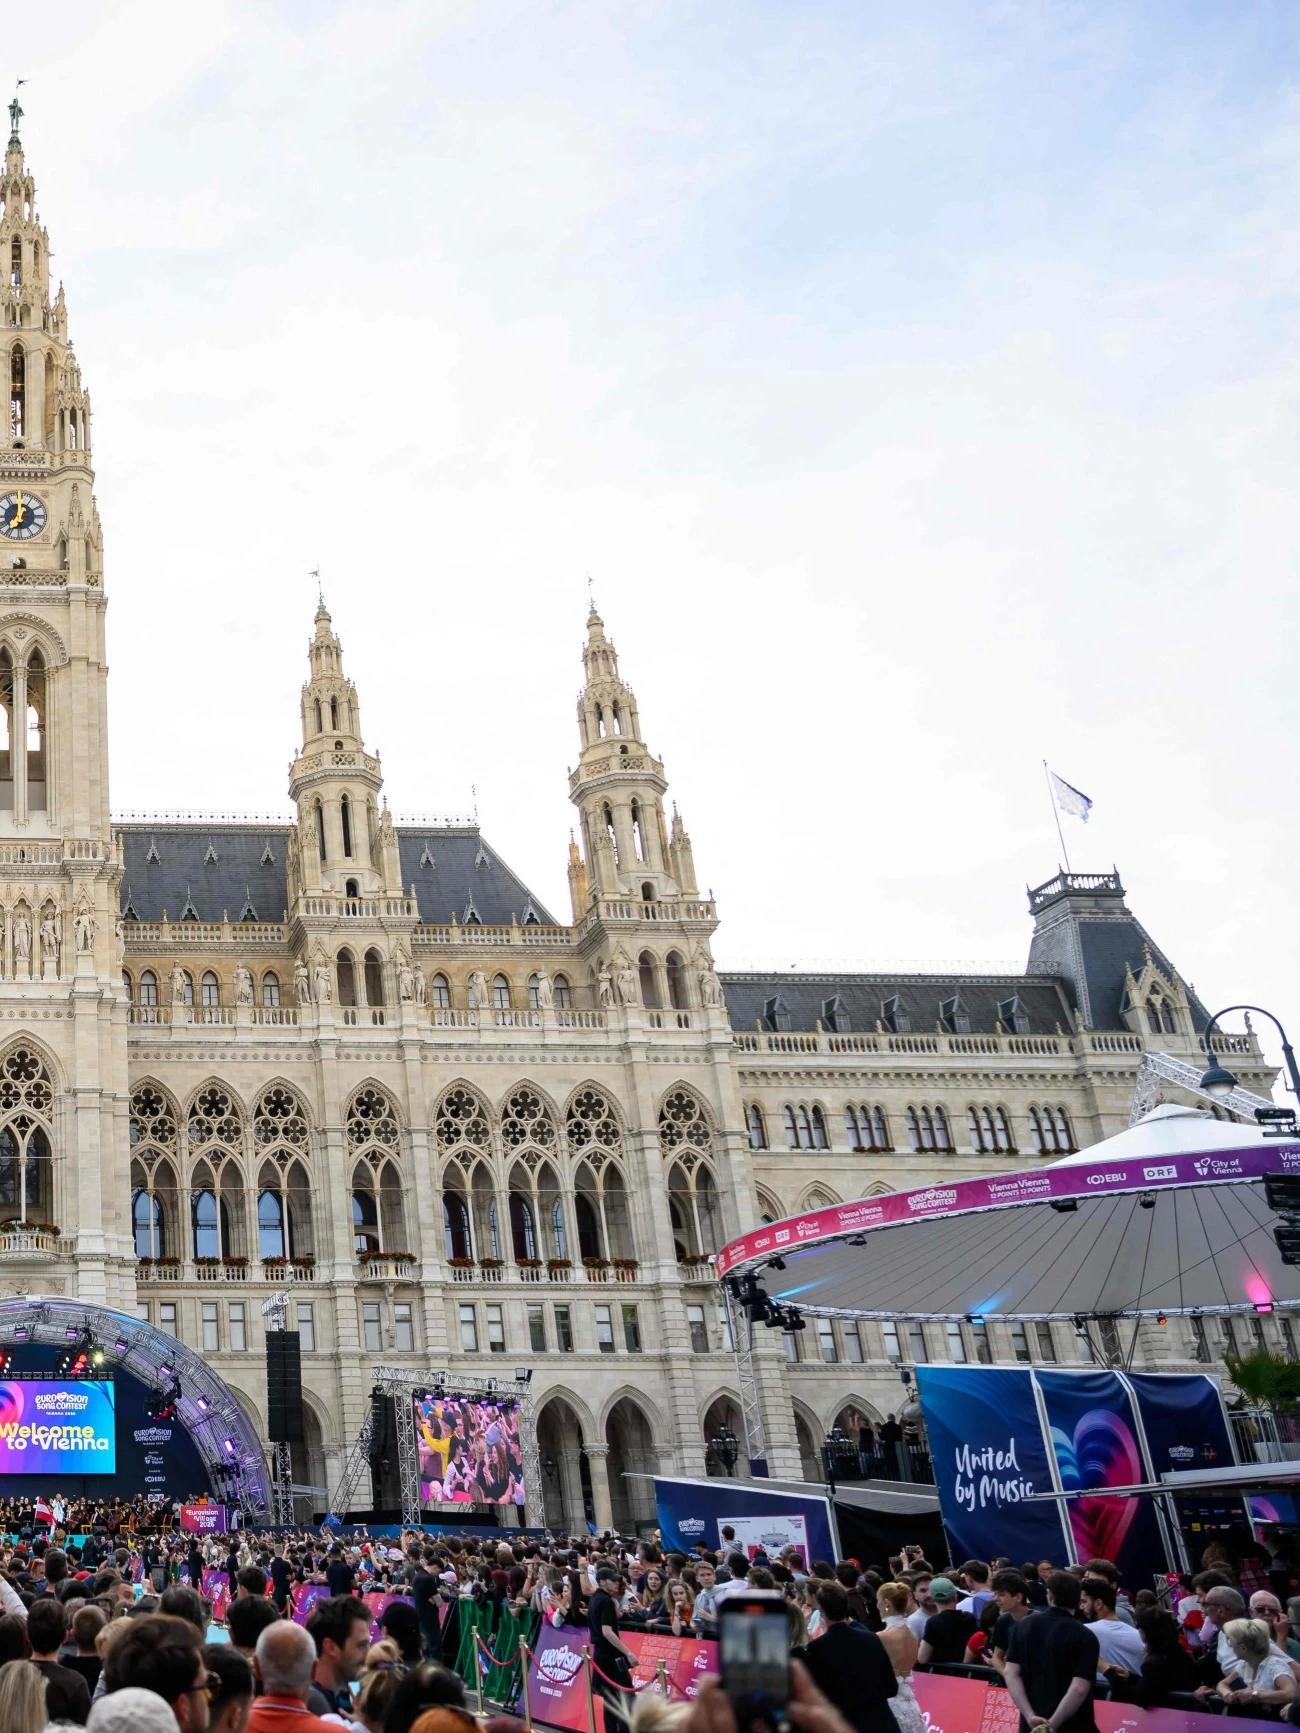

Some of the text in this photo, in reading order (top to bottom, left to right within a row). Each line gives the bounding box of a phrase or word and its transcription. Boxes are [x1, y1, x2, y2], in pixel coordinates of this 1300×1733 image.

[1211, 1160, 1228, 1169] City
[1212, 1167, 1243, 1175] Vienna
[1105, 1172, 1127, 1183] EBU
[1146, 1168, 1174, 1177] ORF
[988, 1178, 1050, 1193] Vienna Vienna
[997, 1190, 1019, 1198] POINTS
[1027, 1185, 1051, 1194] POINTS
[909, 1198, 957, 1211] SONG CONTEST
[837, 1206, 882, 1220] Vienna Vienna
[35, 1392, 88, 1404] EUROVISION
[36, 1402, 87, 1410] SONG CONTEST
[6, 1434, 109, 1450] to Vienna
[955, 1437, 1021, 1478] United
[955, 1473, 1034, 1512] by Music
